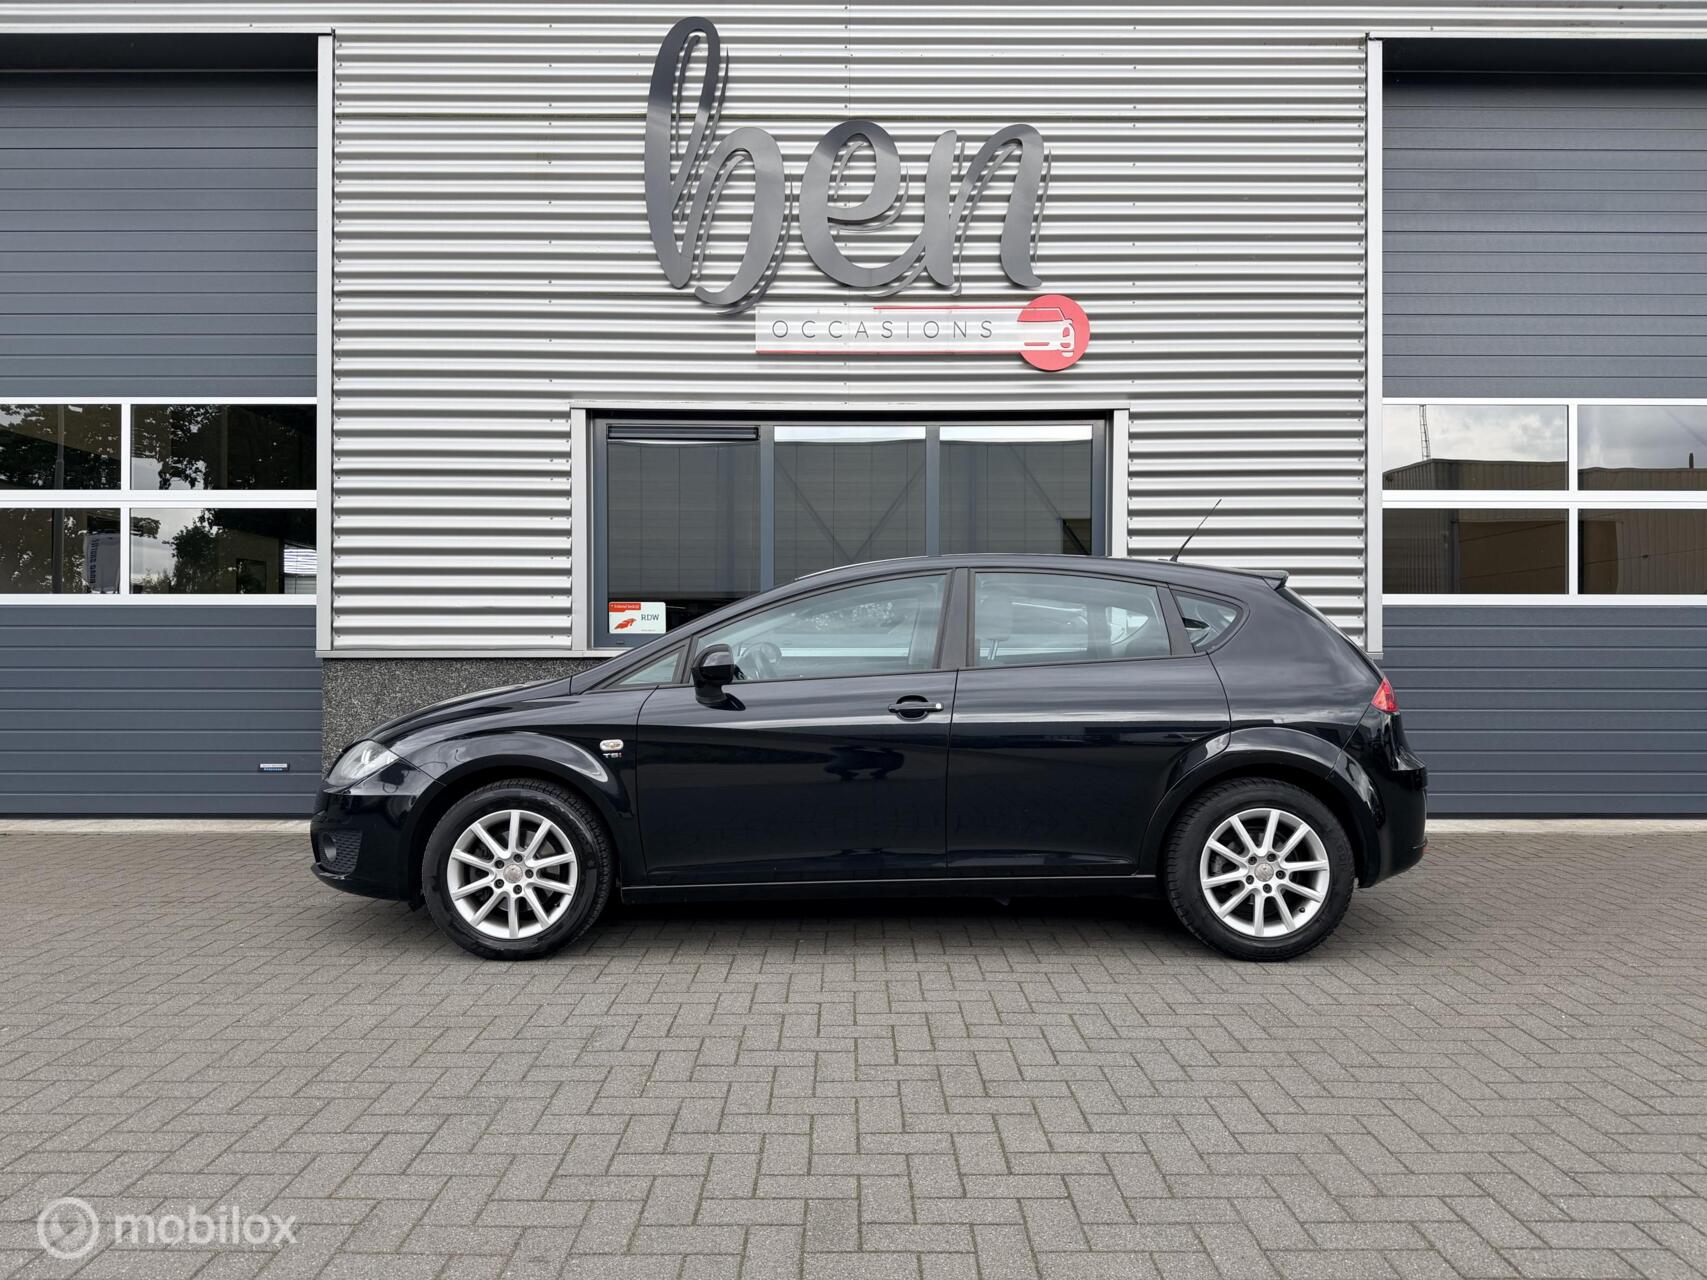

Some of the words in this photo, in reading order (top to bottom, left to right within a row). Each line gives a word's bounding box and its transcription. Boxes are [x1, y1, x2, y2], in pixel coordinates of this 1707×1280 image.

[644, 16, 1045, 306] ben
[771, 319, 995, 340] OCCASIONS
[640, 613, 660, 621] RDW
